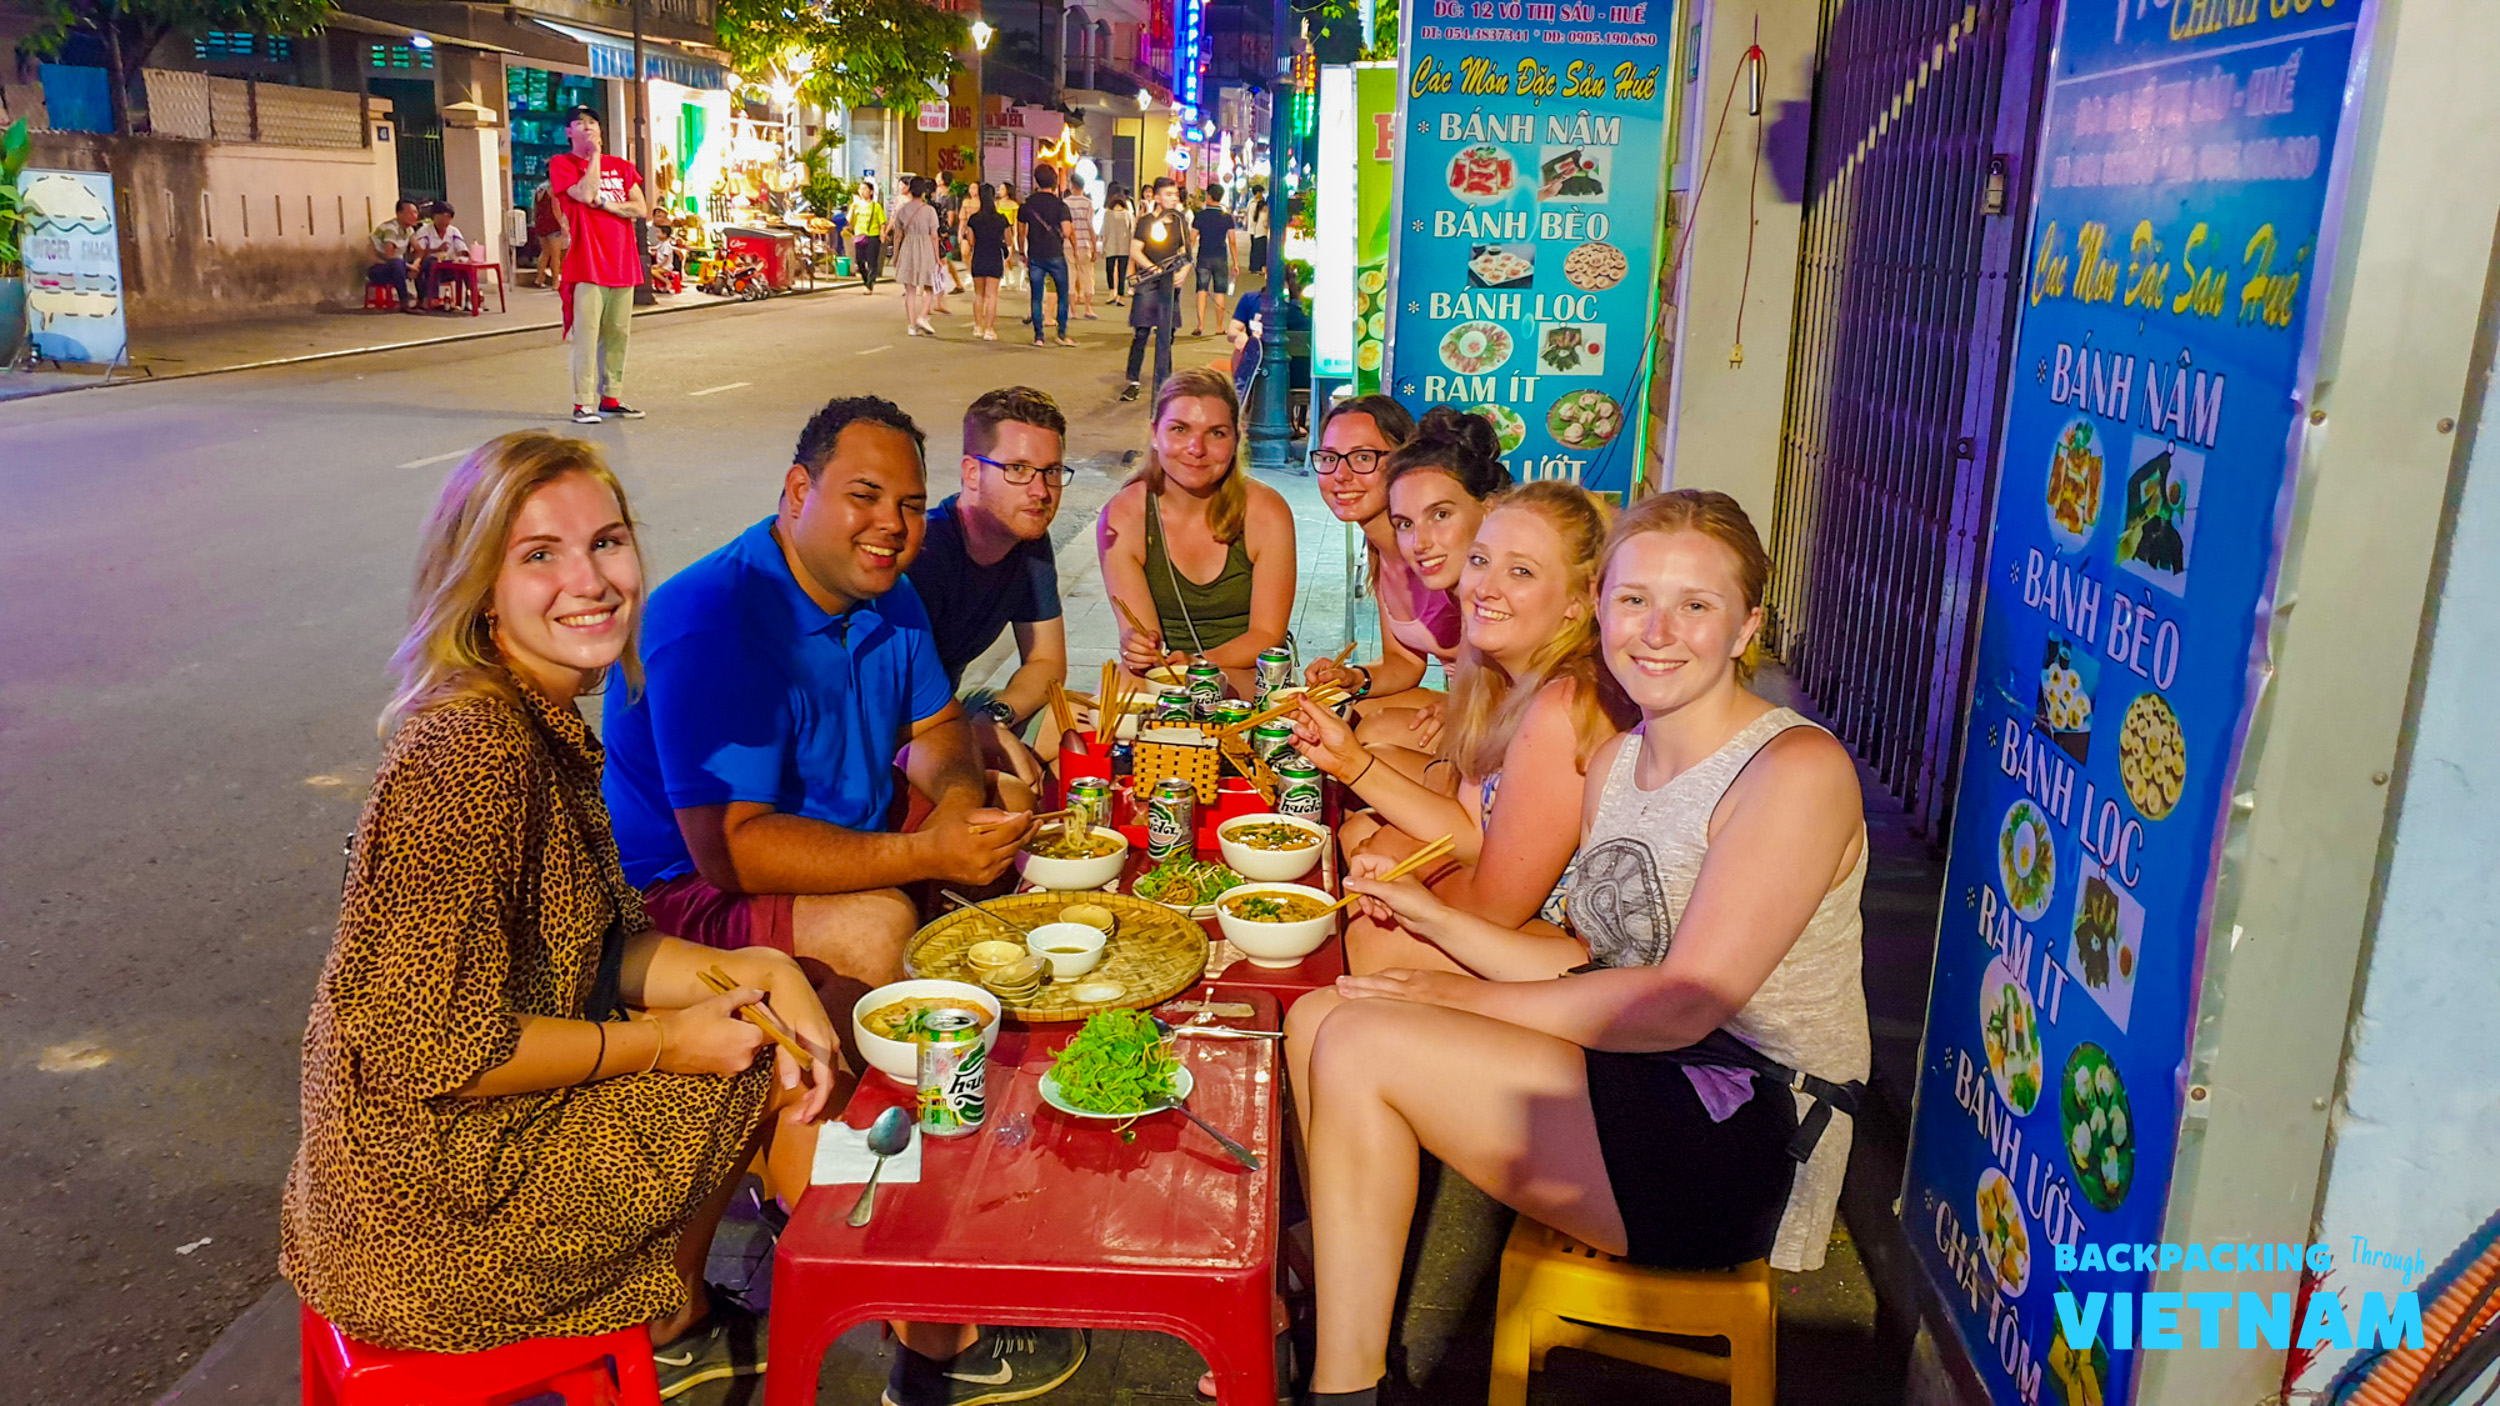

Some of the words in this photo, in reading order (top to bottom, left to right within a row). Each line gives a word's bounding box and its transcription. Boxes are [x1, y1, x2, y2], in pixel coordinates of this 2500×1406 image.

[1471, 2, 1494, 19] 12
[1610, 1, 1648, 24] HUẾ
[1410, 54, 1452, 100] Các
[1460, 55, 1510, 98] Món
[1613, 61, 1661, 101] Huế
[1439, 106, 1534, 143] BÁNH
[1433, 203, 1527, 238] BÁNH
[1540, 205, 1610, 241] BÈO
[1429, 285, 1522, 320] BÁNH
[1424, 375, 1496, 402] RAM
[1509, 369, 1541, 402] ÍT
[2050, 331, 2135, 421] BÁNH
[2023, 545, 2102, 644] BÁNH
[2106, 588, 2180, 691] BÈO
[2000, 716, 2074, 828] BÁNH
[1978, 884, 2034, 991] RAM
[2037, 940, 2069, 1026] ÍT
[1954, 1048, 2022, 1184] BÁNH
[1988, 1287, 2042, 1406] TÔM
